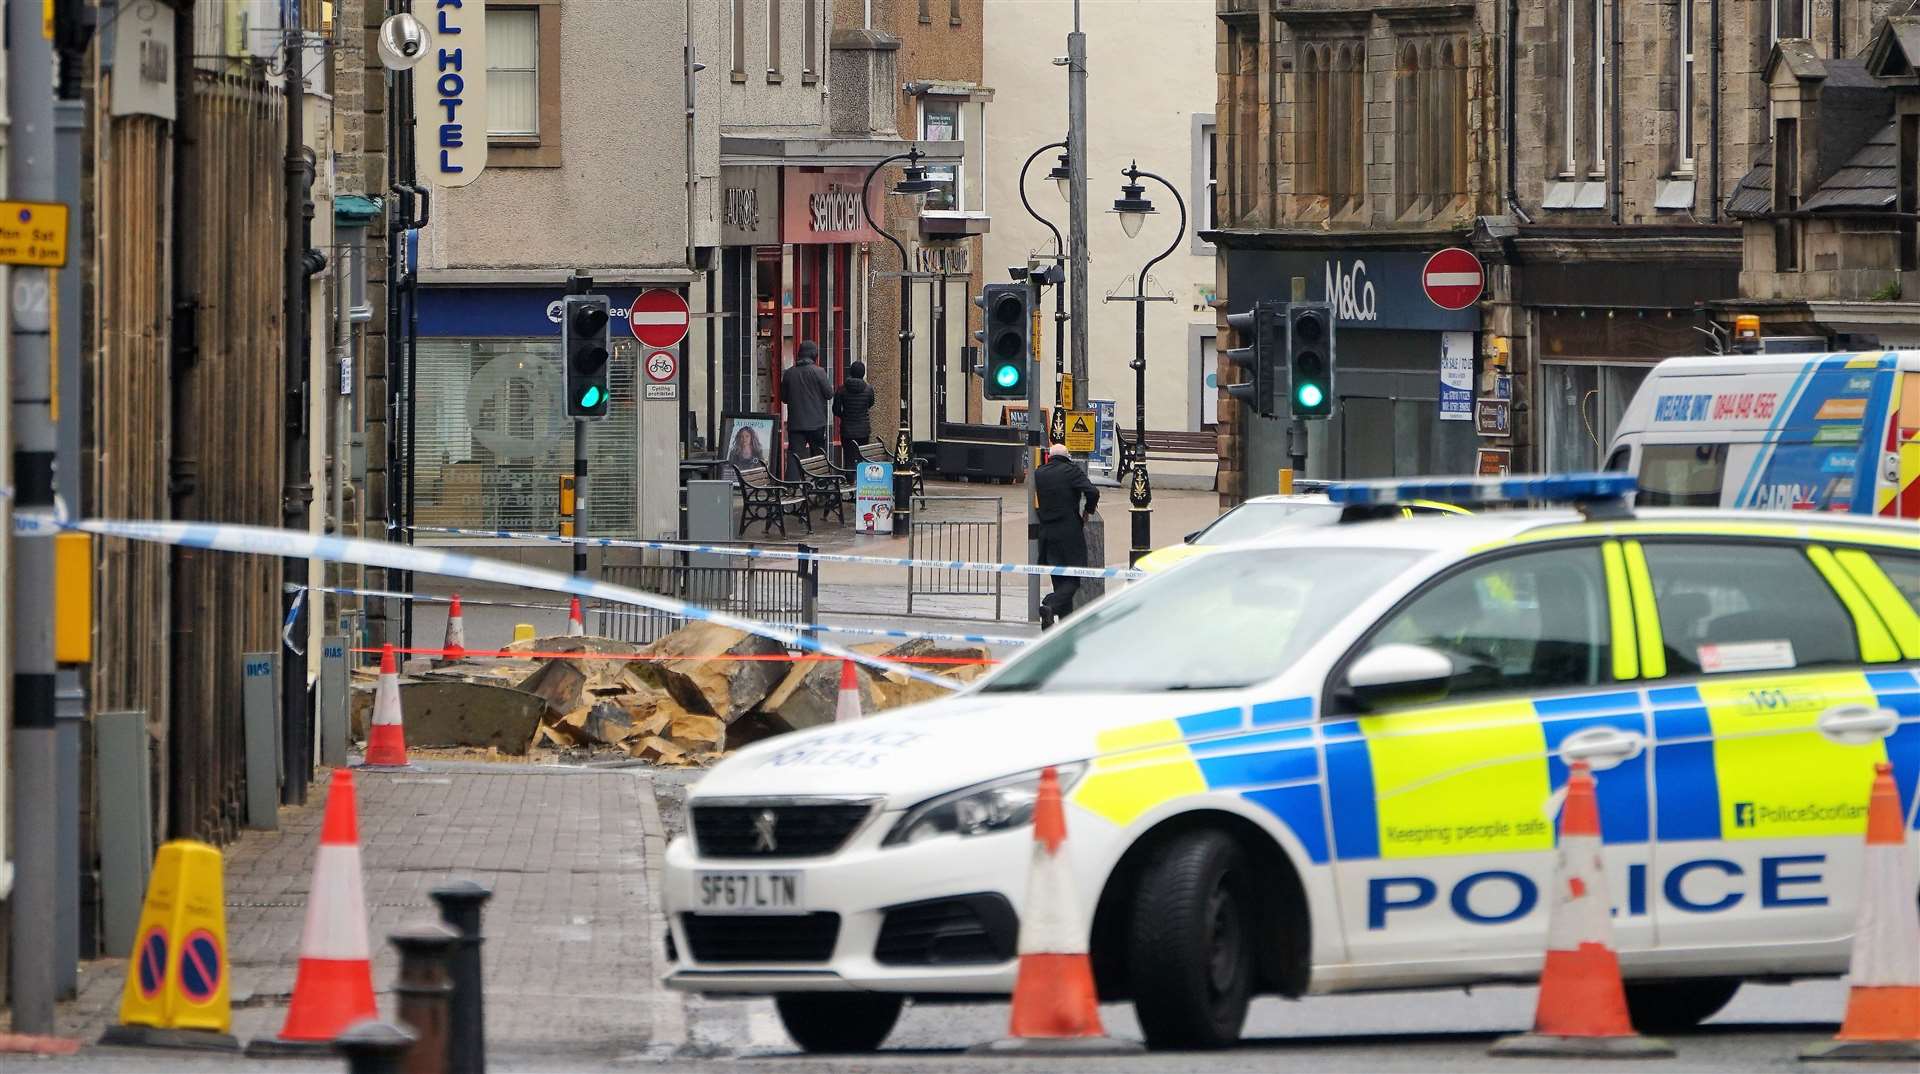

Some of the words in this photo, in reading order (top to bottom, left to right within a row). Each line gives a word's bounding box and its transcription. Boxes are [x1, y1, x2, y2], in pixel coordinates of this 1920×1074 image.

[437, 48, 464, 173] HOTEL
[812, 192, 862, 232] semichem
[1325, 259, 1377, 320] M&Co.
[1655, 395, 1692, 421] WELFARE
[1691, 394, 1712, 420] UNIT
[1750, 690, 1788, 708] 101
[1759, 804, 1870, 822] PoliceScotlan
[1387, 825, 1451, 844] Keeping
[1456, 821, 1511, 839] people
[1516, 818, 1547, 835] safe
[700, 875, 748, 905] SF67
[754, 875, 796, 904] LTN
[1368, 854, 1828, 931] POICE
